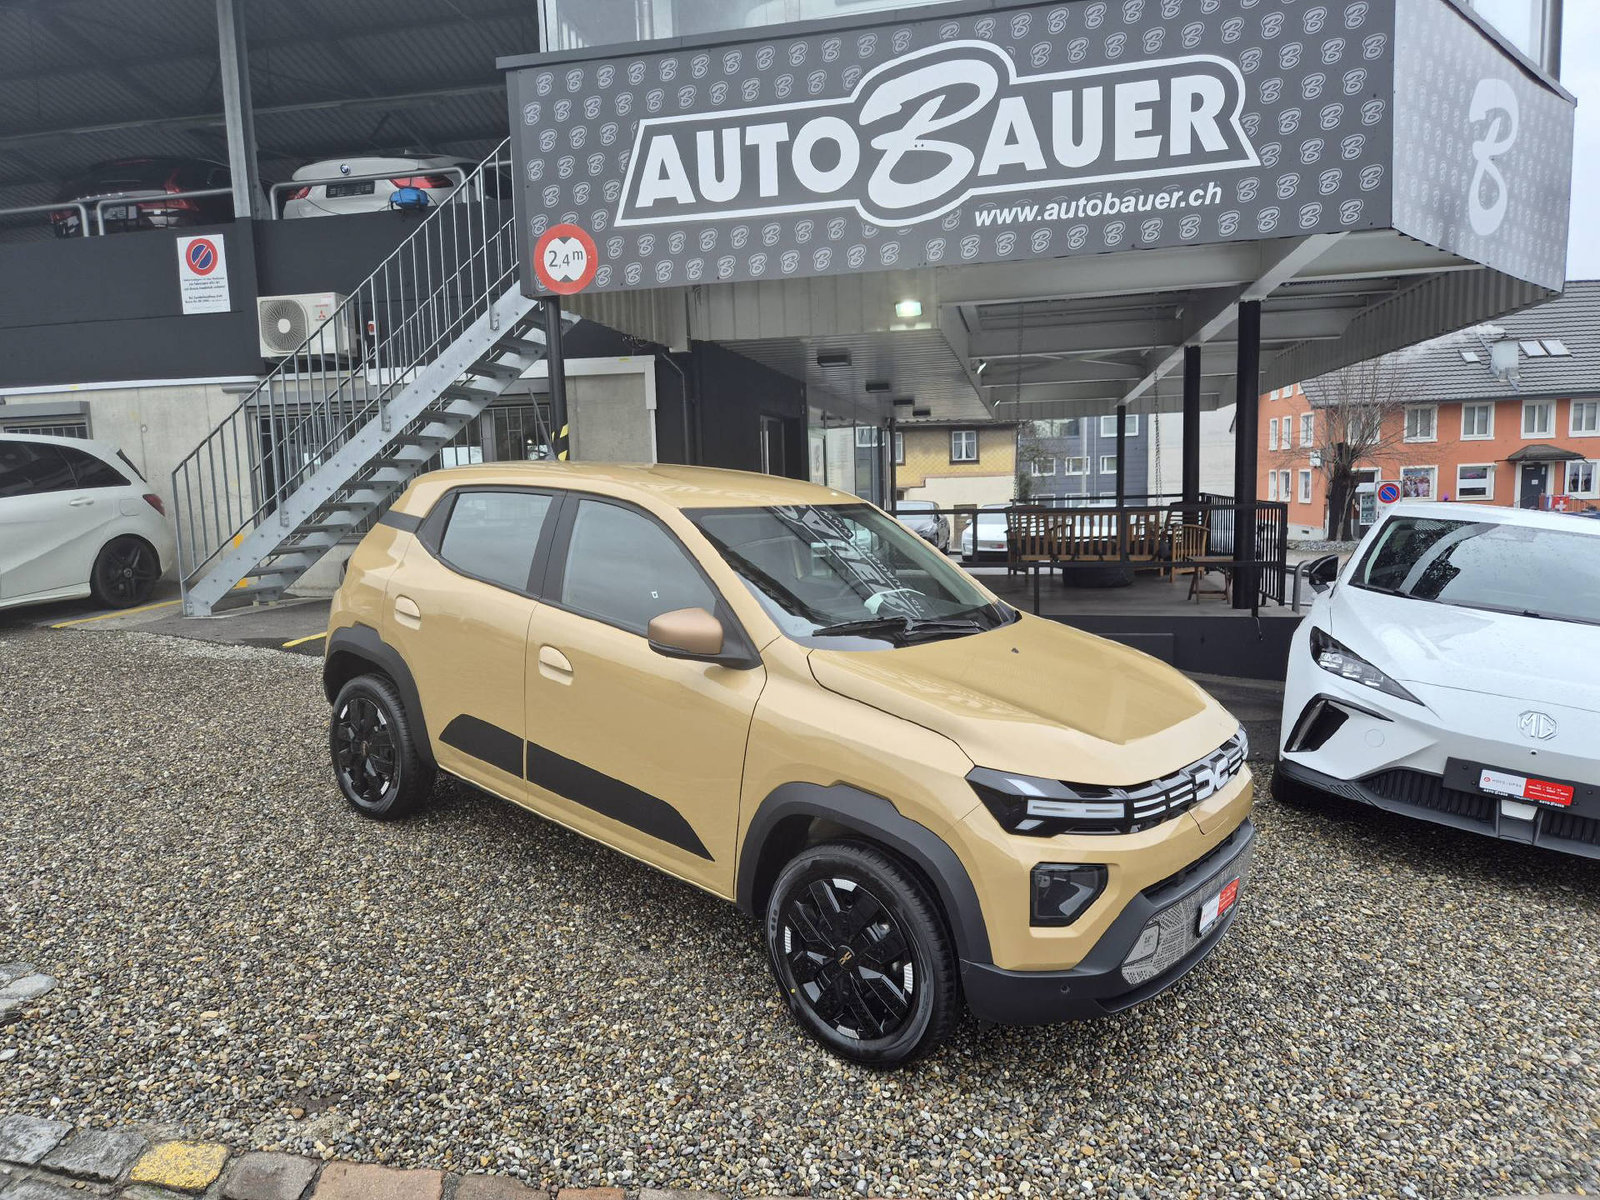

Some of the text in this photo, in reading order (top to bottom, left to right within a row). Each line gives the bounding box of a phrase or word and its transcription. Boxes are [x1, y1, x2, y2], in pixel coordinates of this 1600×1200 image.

[635, 59, 1229, 209] AUTO BAUER
[975, 182, 1222, 227] www.autobauer.ch
